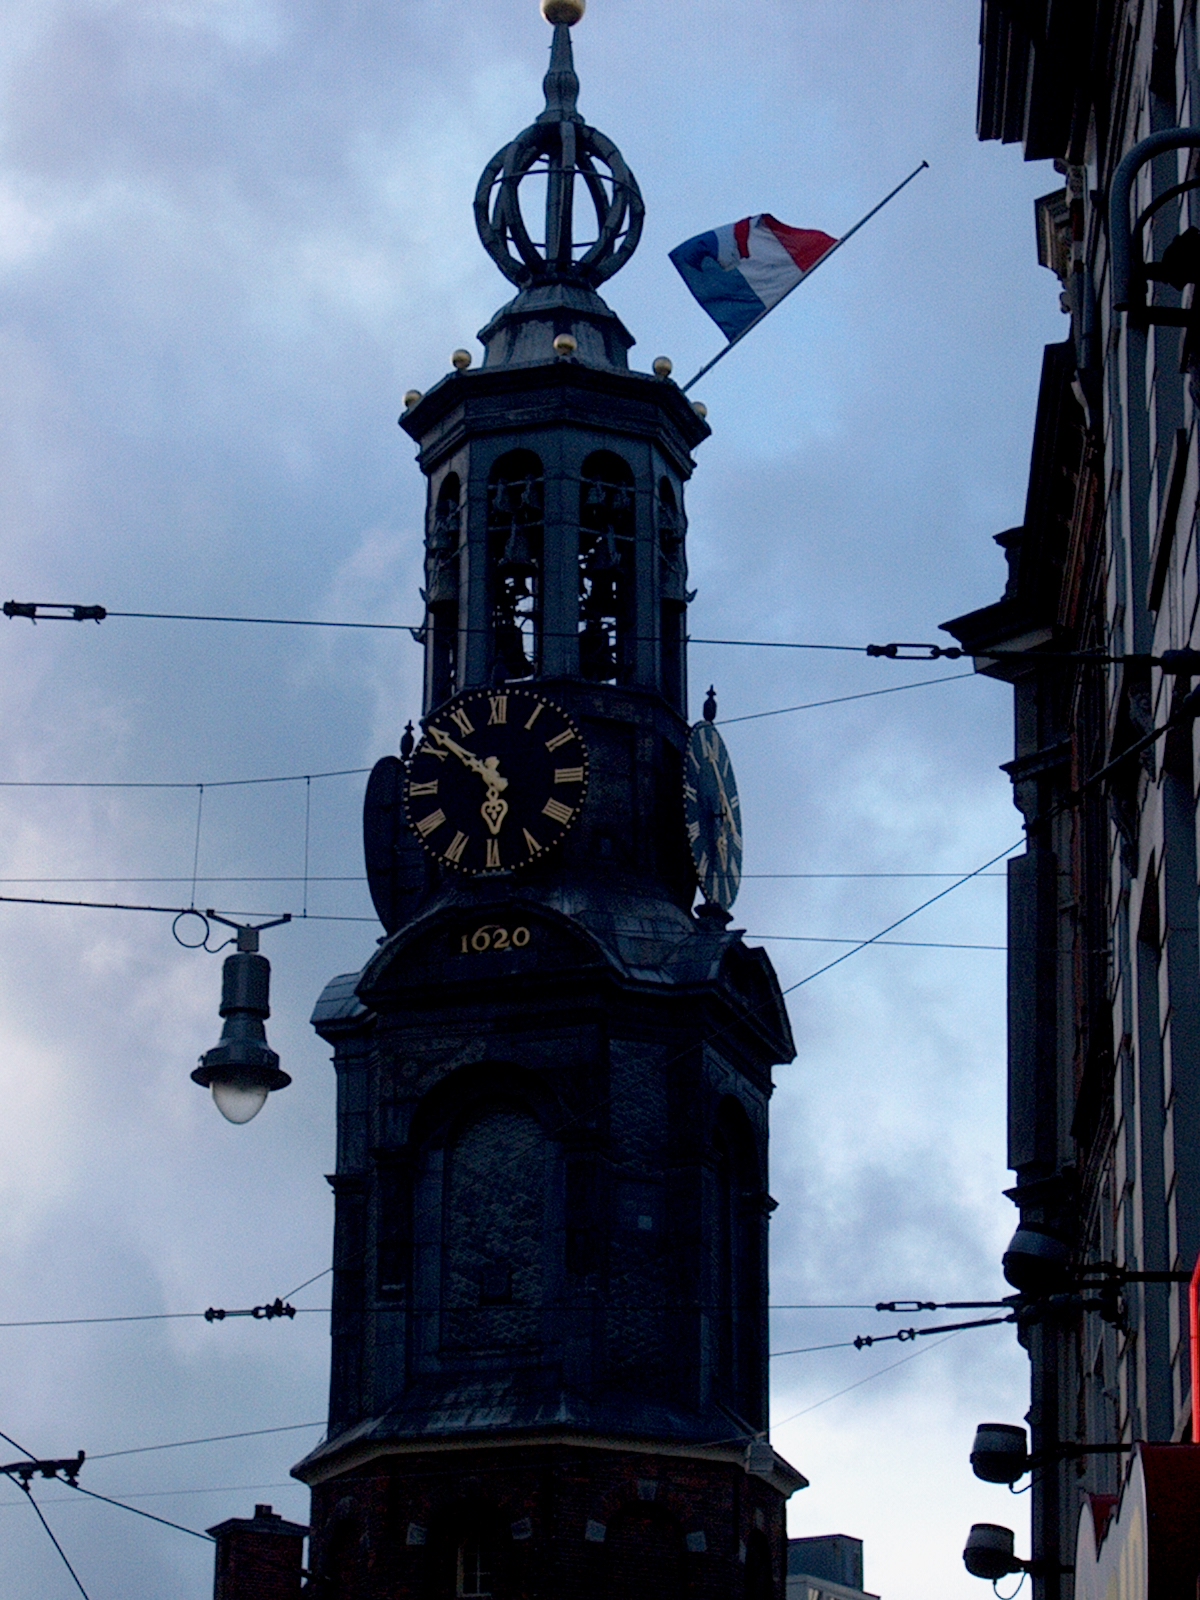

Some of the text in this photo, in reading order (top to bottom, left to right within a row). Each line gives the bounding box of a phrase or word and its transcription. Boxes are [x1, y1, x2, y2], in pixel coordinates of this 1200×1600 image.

[449, 707, 475, 738] XI
[487, 695, 508, 726] XII
[420, 740, 449, 763] X
[544, 727, 576, 753] II
[409, 778, 439, 797] IX
[554, 766, 584, 784] III
[415, 807, 447, 838] VIII
[443, 829, 470, 864] VII
[522, 827, 543, 856] V
[461, 925, 531, 953] 1620
